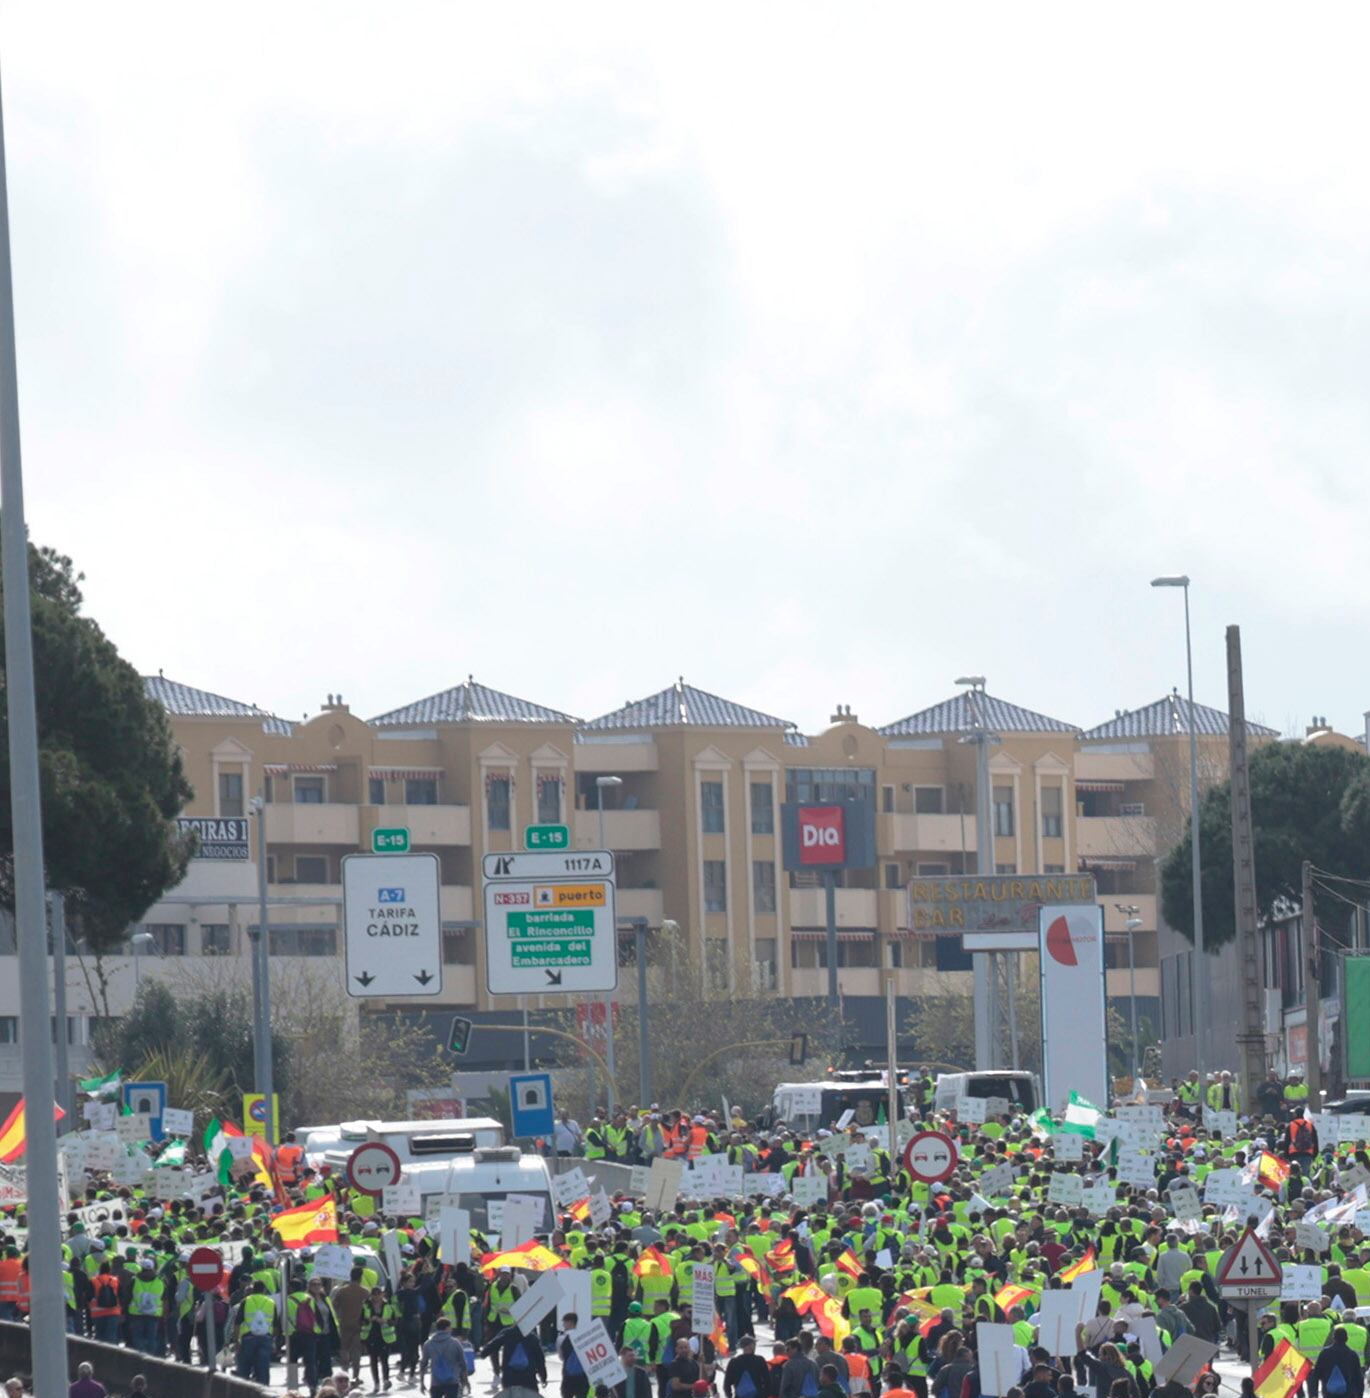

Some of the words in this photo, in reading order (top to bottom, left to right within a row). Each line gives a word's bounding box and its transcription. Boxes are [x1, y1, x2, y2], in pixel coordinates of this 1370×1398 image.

[377, 834, 404, 846] E-15
[531, 832, 563, 843] E-15
[564, 858, 602, 871] 1117A
[380, 889, 402, 901] A-7
[911, 878, 1093, 902] RESTAURANTE
[559, 890, 603, 903] puerto
[368, 907, 416, 920] TARIFA
[525, 912, 575, 924] barriada
[914, 907, 965, 929] BAR
[367, 920, 420, 938] CÁDIZ
[509, 927, 520, 937] El
[527, 926, 593, 937] Rinconcillo
[516, 943, 562, 953] avenida
[568, 941, 586, 952] del
[512, 955, 591, 967] Embarcadero
[1236, 1287, 1268, 1297] TUNEL
[585, 1343, 608, 1365] NO
